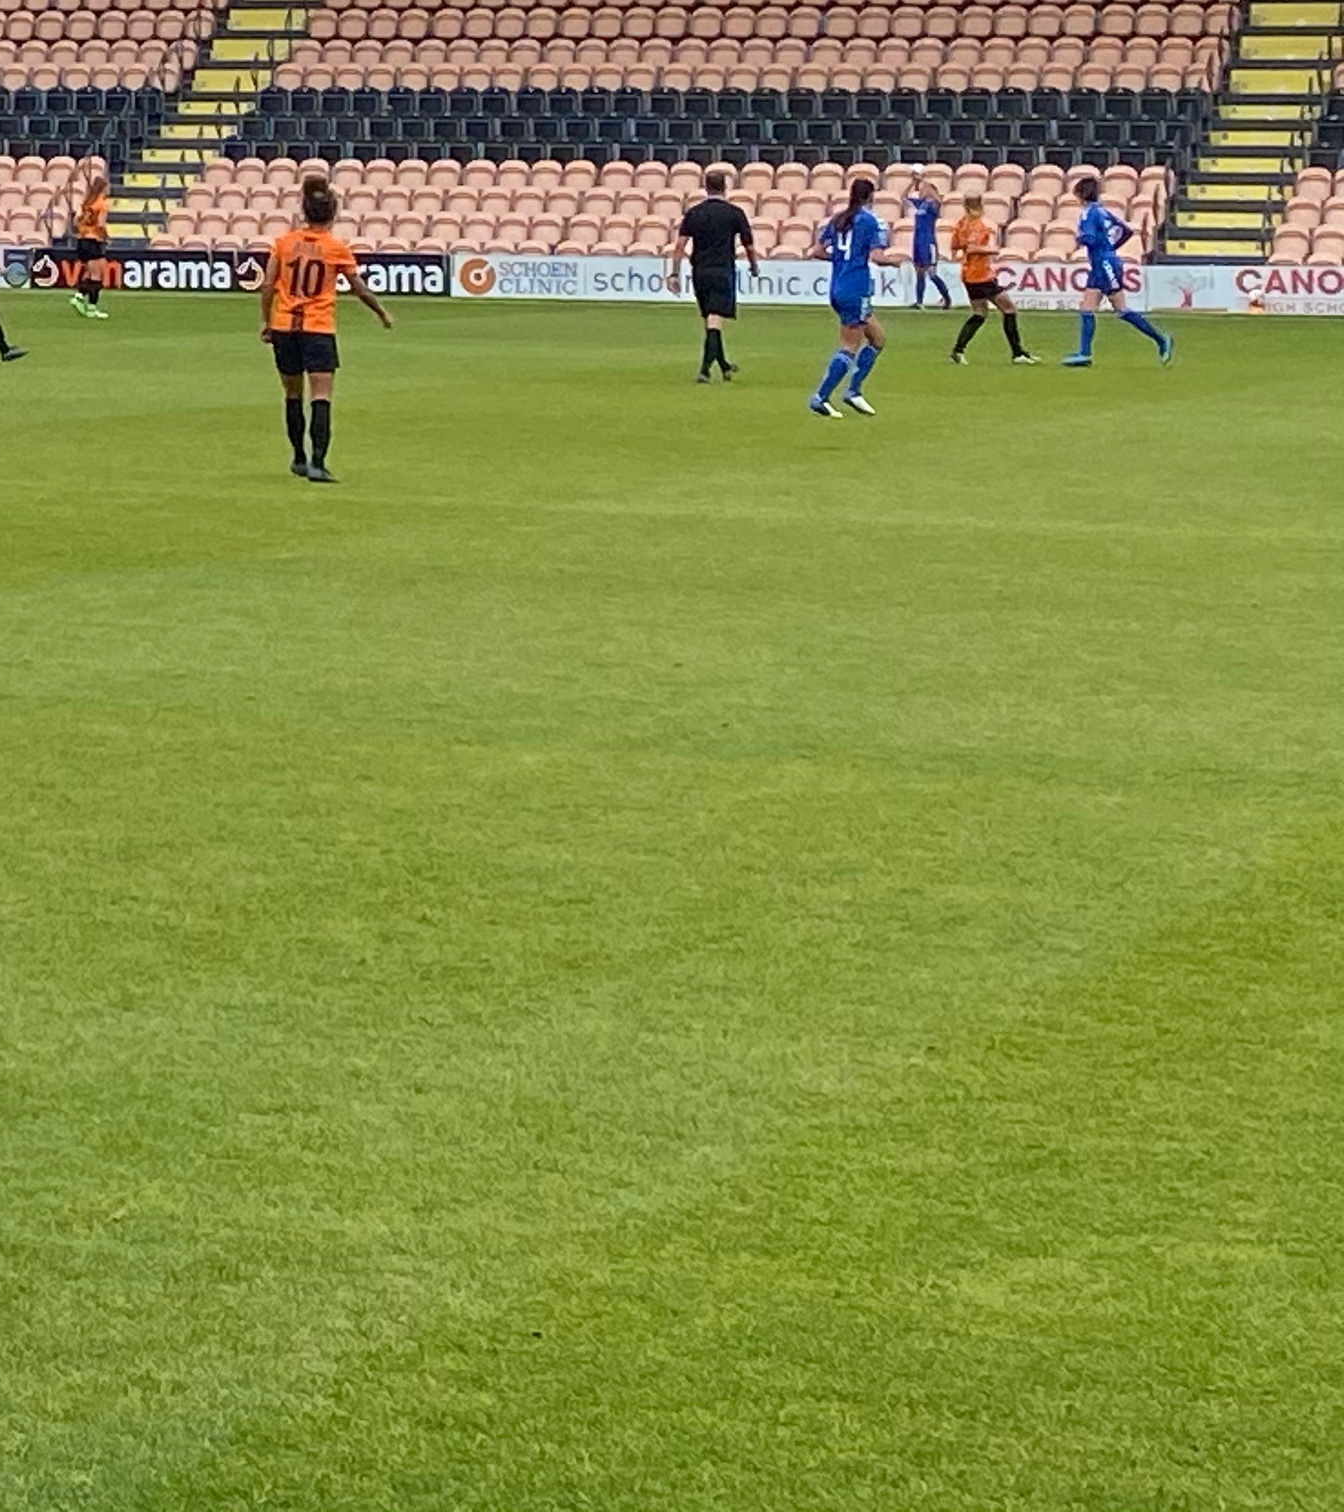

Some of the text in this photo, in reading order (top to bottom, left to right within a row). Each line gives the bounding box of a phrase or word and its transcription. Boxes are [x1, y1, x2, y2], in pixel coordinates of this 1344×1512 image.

[837, 229, 853, 261] 4
[285, 255, 326, 298] 10
[499, 261, 579, 278] SCHOEN
[499, 277, 579, 296] CLINIC
